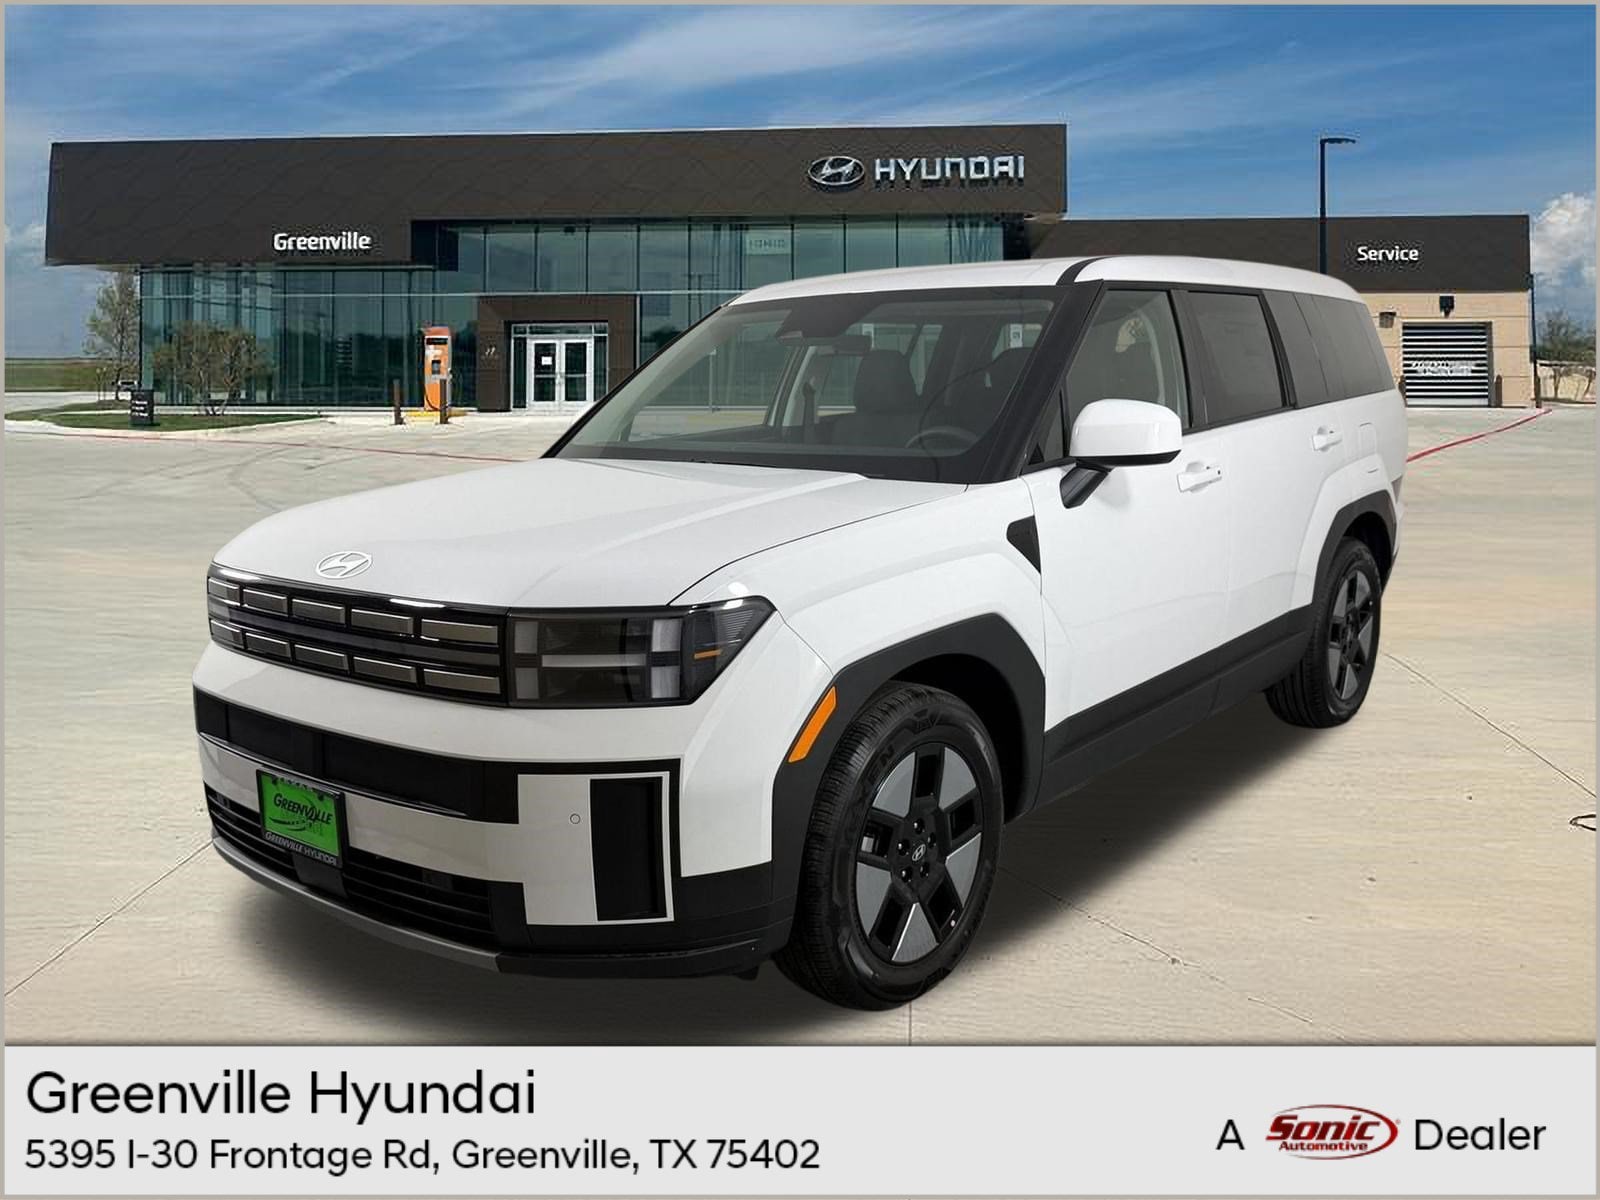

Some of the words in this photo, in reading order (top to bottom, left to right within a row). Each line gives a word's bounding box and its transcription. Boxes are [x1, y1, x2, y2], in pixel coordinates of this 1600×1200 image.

[874, 155, 1025, 181] HYUNDAI
[273, 231, 371, 251] Greenville
[1357, 245, 1419, 261] Service
[273, 793, 333, 825] GREENVILLE
